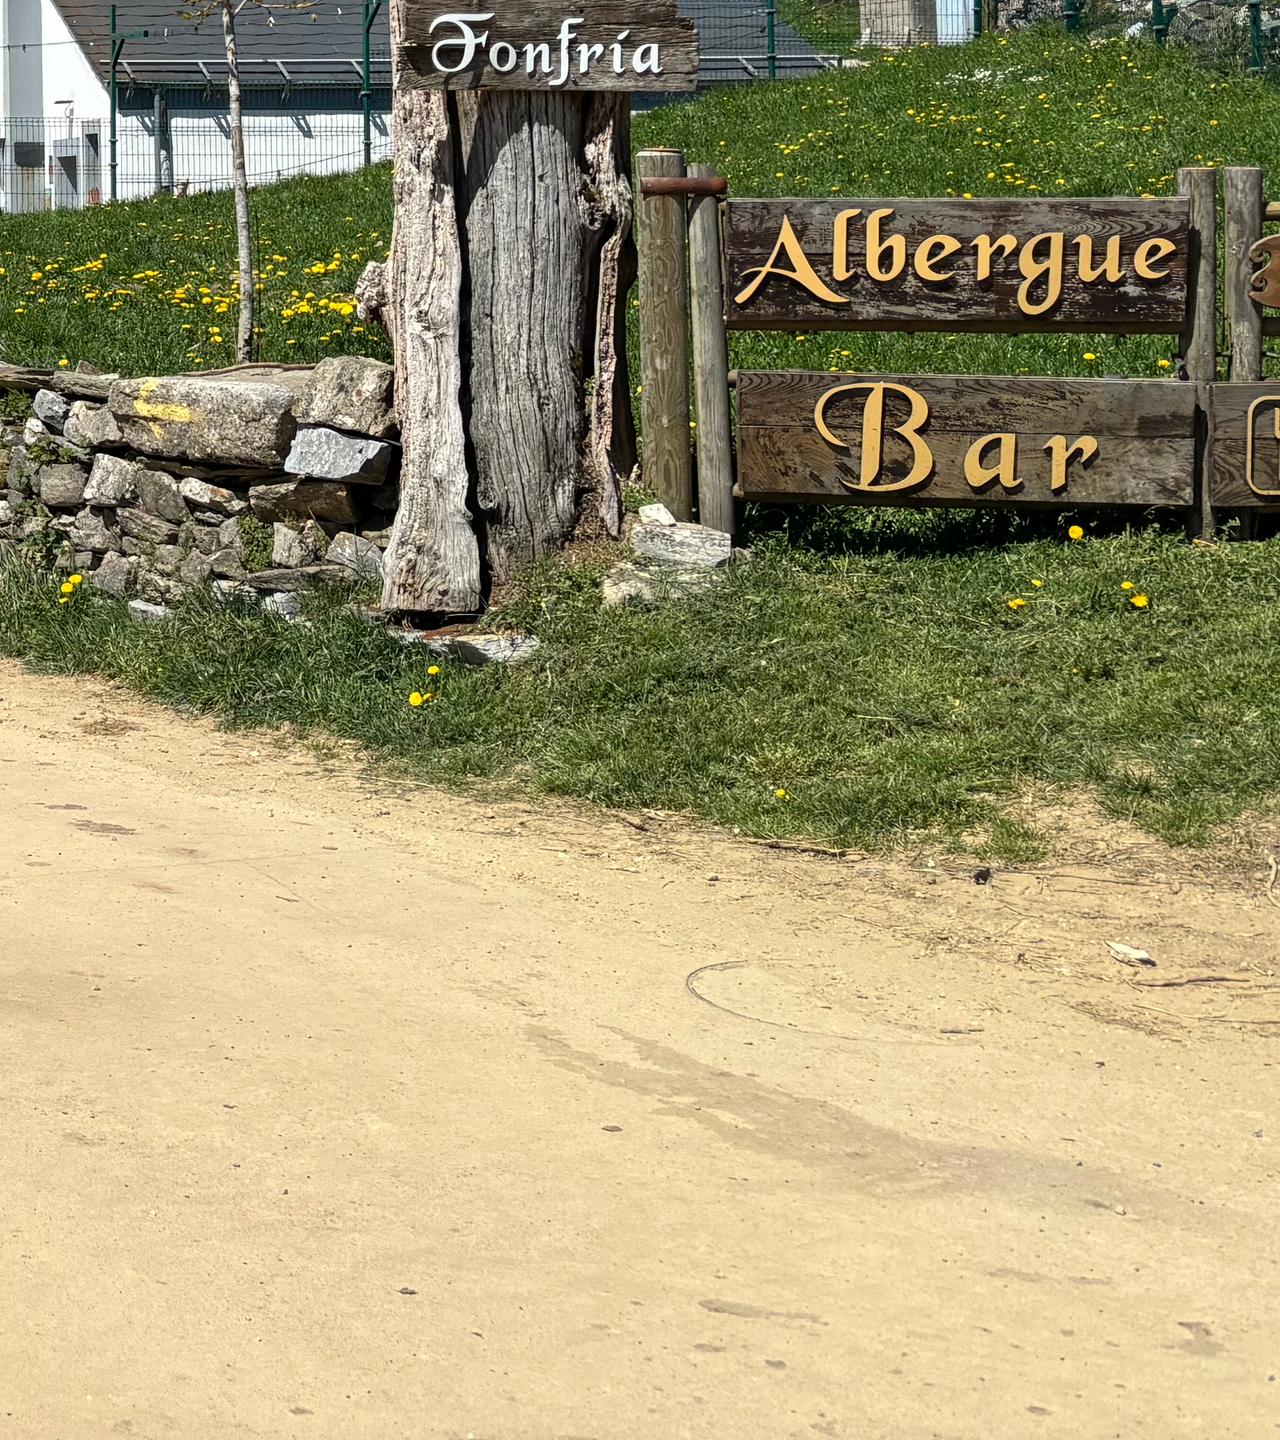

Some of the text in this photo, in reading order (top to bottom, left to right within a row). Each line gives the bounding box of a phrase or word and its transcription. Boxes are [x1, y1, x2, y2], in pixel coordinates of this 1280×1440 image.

[428, 12, 663, 86] Fonfría
[734, 208, 1177, 316] Albergue
[813, 380, 1101, 492] Bar
